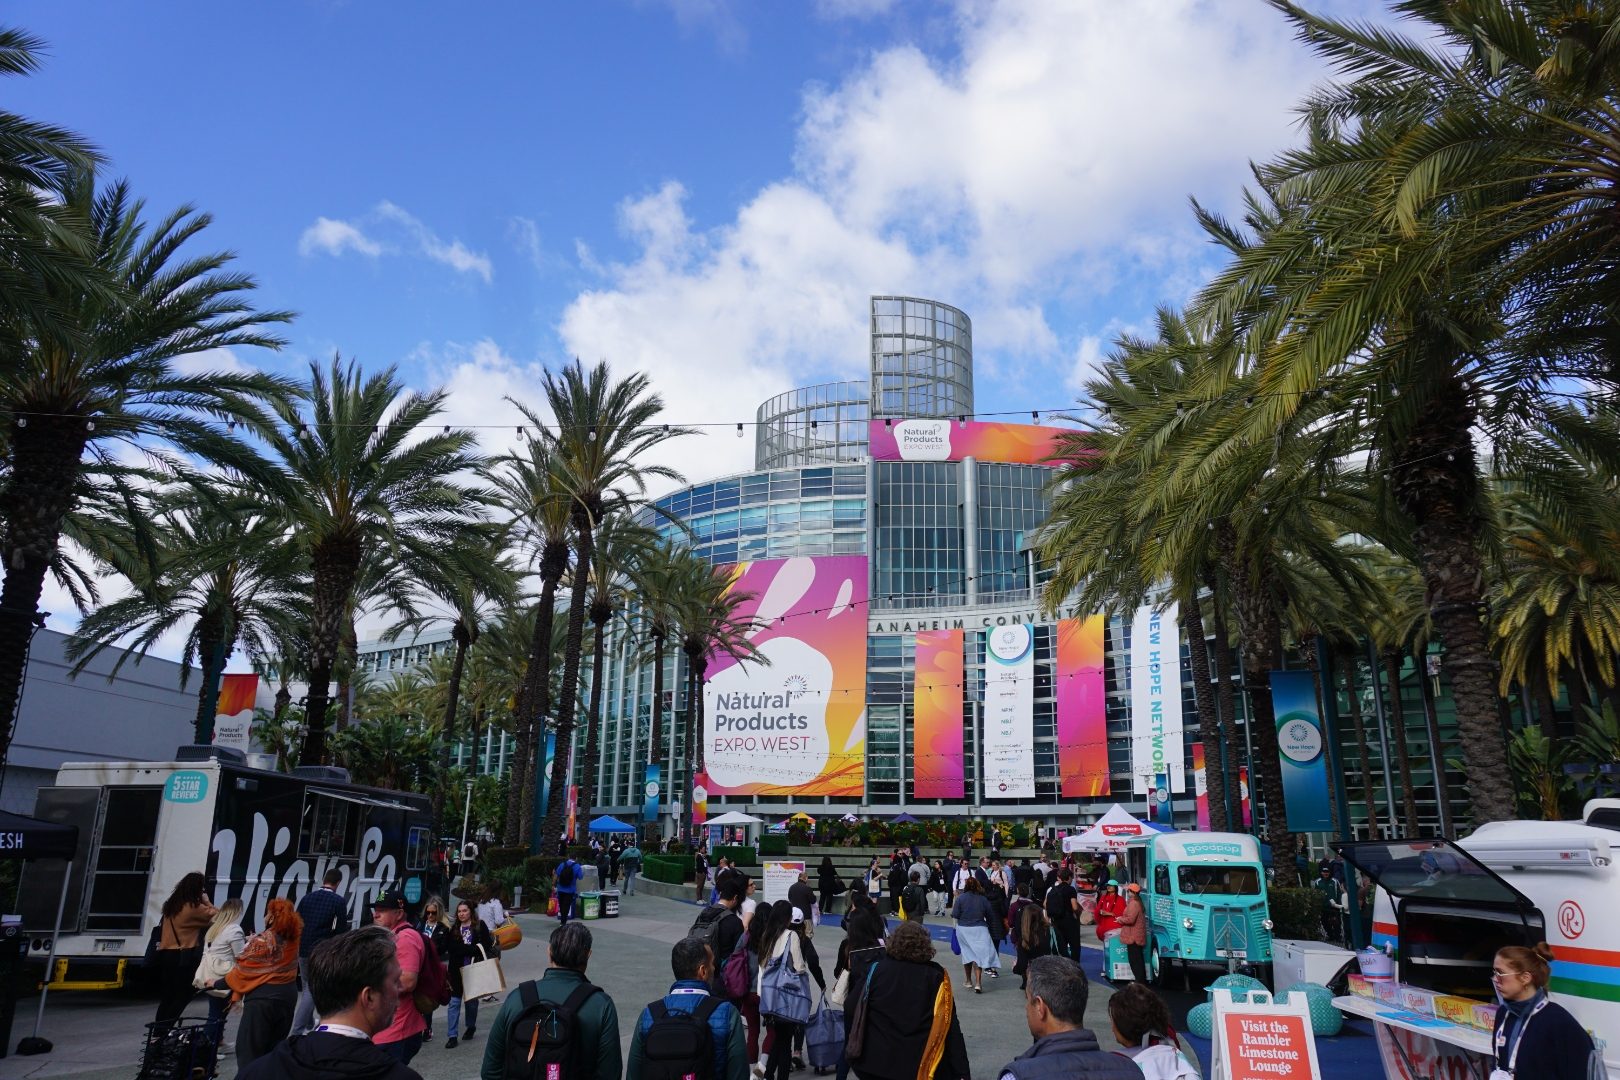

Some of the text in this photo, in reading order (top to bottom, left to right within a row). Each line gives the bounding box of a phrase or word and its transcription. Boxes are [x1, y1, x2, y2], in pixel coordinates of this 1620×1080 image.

[904, 428, 936, 436] Natural
[876, 619, 964, 632] ANAHEIM
[1149, 611, 1161, 645] NEW
[1149, 651, 1162, 696] HOPE
[716, 690, 790, 711] Natural
[715, 712, 808, 731] Products
[714, 736, 810, 752] EXPO WEST
[173, 776, 200, 790] 5 STAR
[171, 790, 199, 799] REVIEWS
[1187, 845, 1239, 854] goodpop
[1240, 1020, 1289, 1033] Visit the
[1242, 1032, 1291, 1046] Rambler
[1239, 1045, 1299, 1060] Limestone
[1249, 1059, 1292, 1075] Lounge
